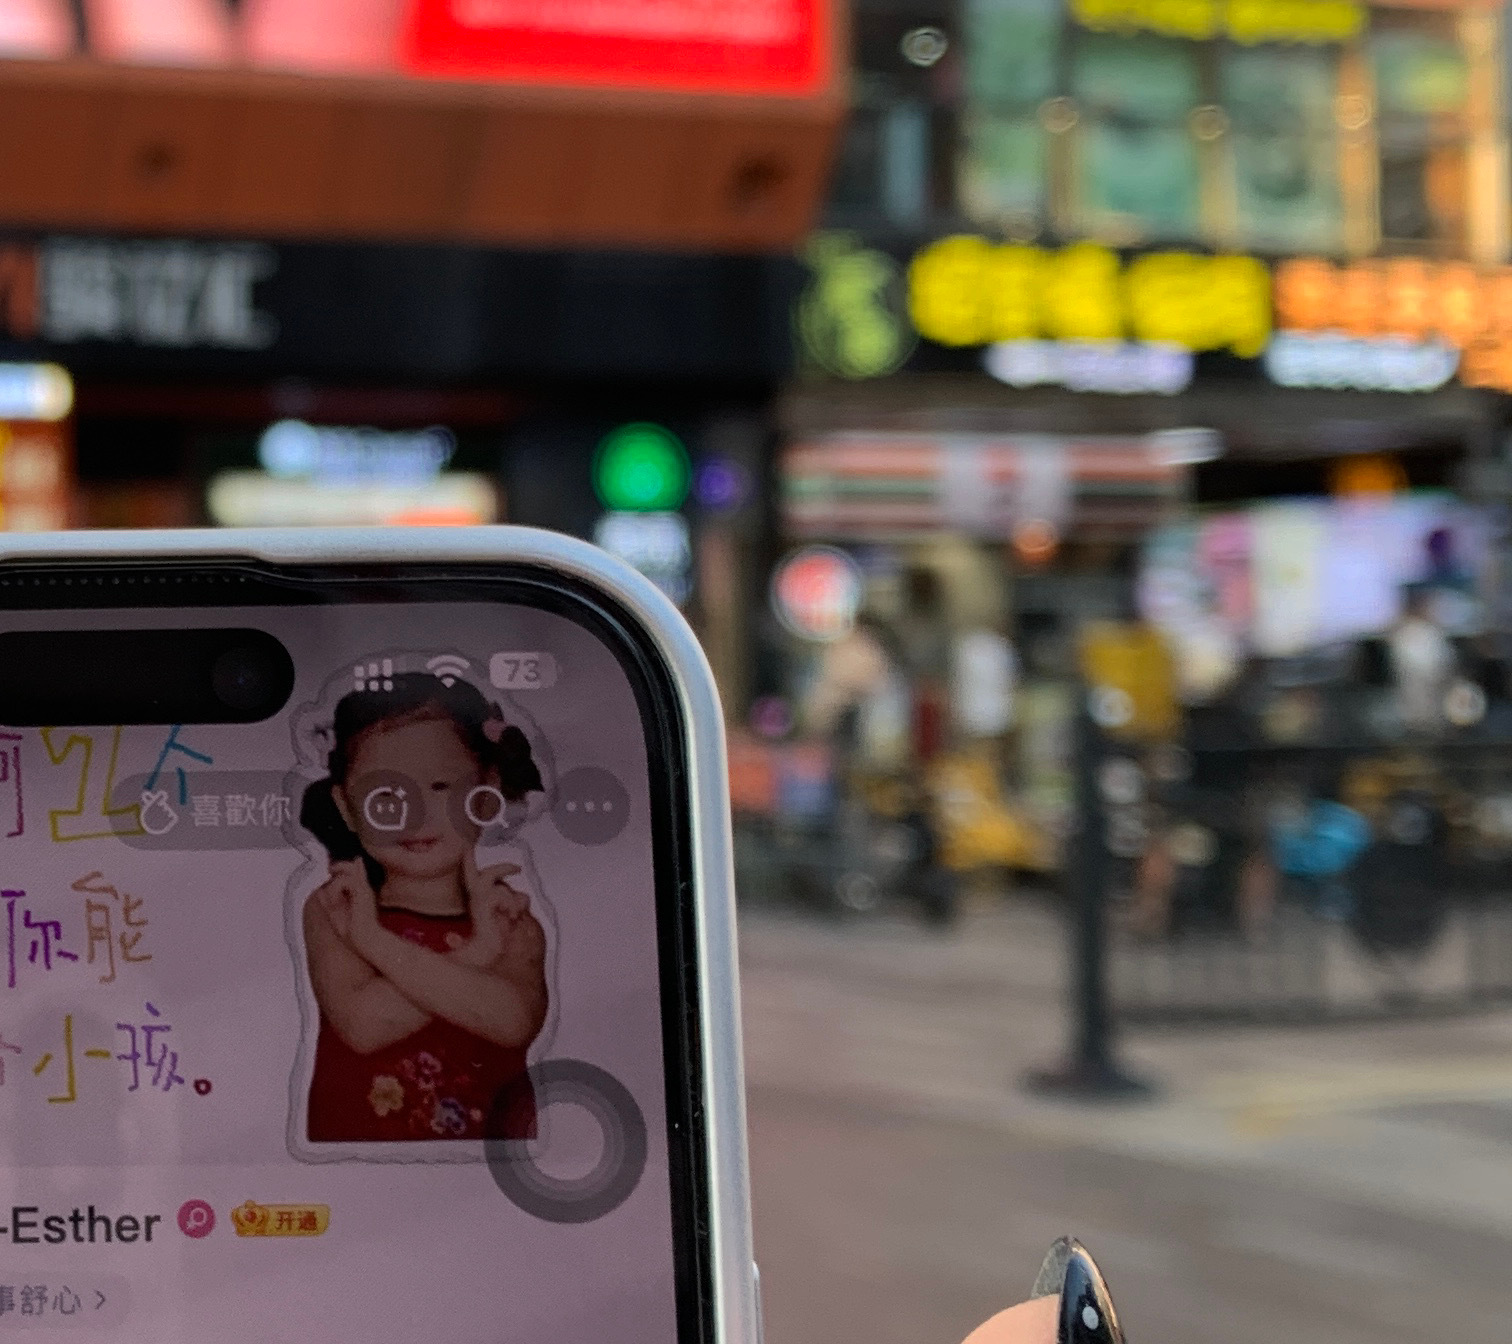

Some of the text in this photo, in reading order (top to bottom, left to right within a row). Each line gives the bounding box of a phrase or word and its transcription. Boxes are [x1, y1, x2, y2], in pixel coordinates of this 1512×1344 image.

[503, 659, 539, 683] 73
[191, 794, 291, 827] 喜歡你
[274, 1209, 318, 1232] 开通
